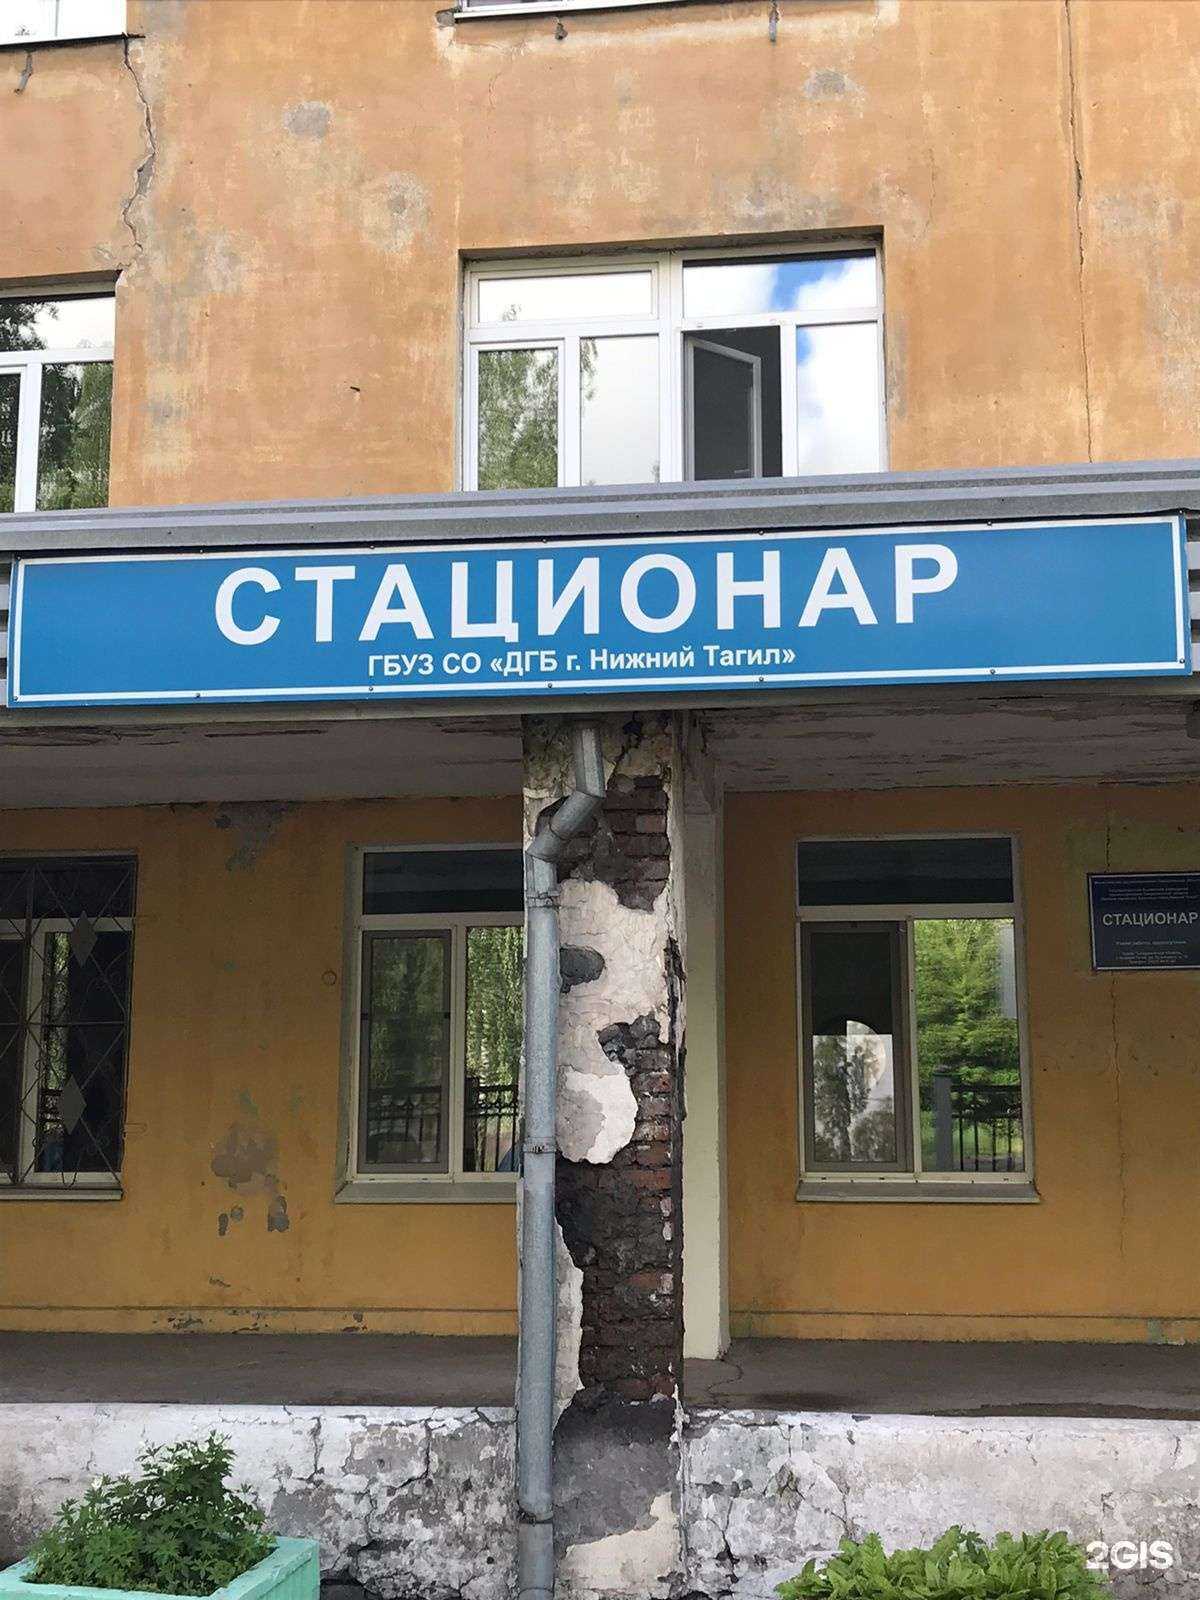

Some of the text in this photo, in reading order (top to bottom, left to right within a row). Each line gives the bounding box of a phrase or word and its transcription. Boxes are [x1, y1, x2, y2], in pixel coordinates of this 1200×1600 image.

[215, 543, 959, 646] СТАЦИОНАР
[367, 645, 797, 677] ГБУЗ СО «ДГБ г. Нижний Тагил»
[1102, 911, 1198, 927] СТАЦИОНАР
